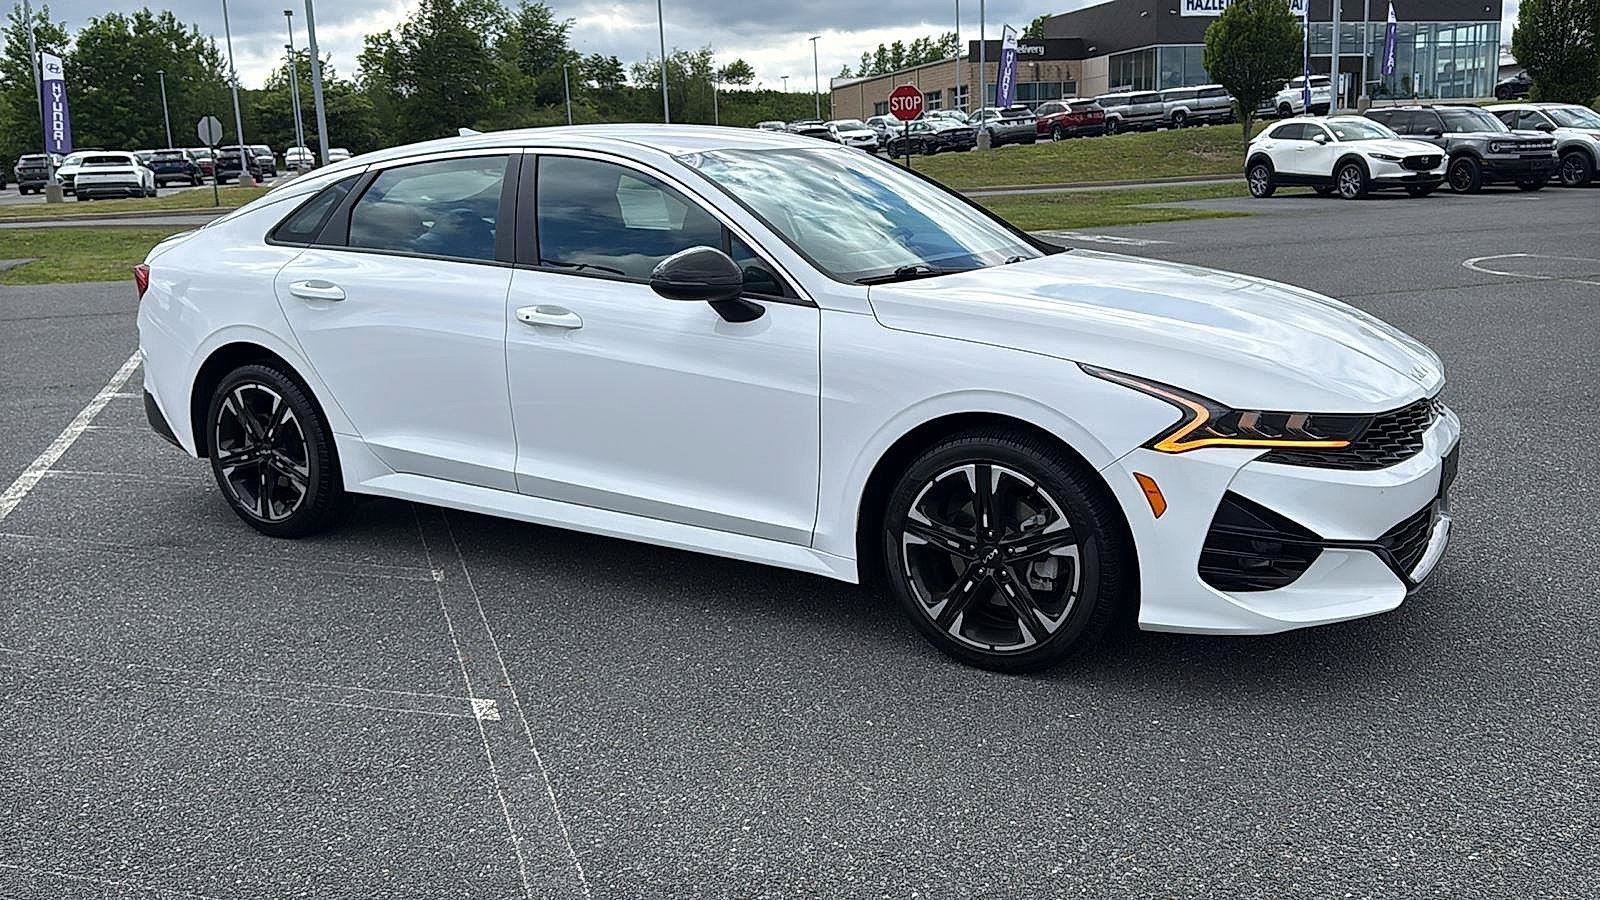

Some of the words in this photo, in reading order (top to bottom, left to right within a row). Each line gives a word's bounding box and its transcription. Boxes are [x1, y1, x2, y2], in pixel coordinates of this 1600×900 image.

[1017, 44, 1044, 56] elivery
[891, 96, 921, 111] STOP
[52, 82, 64, 150] HYUNDAI
